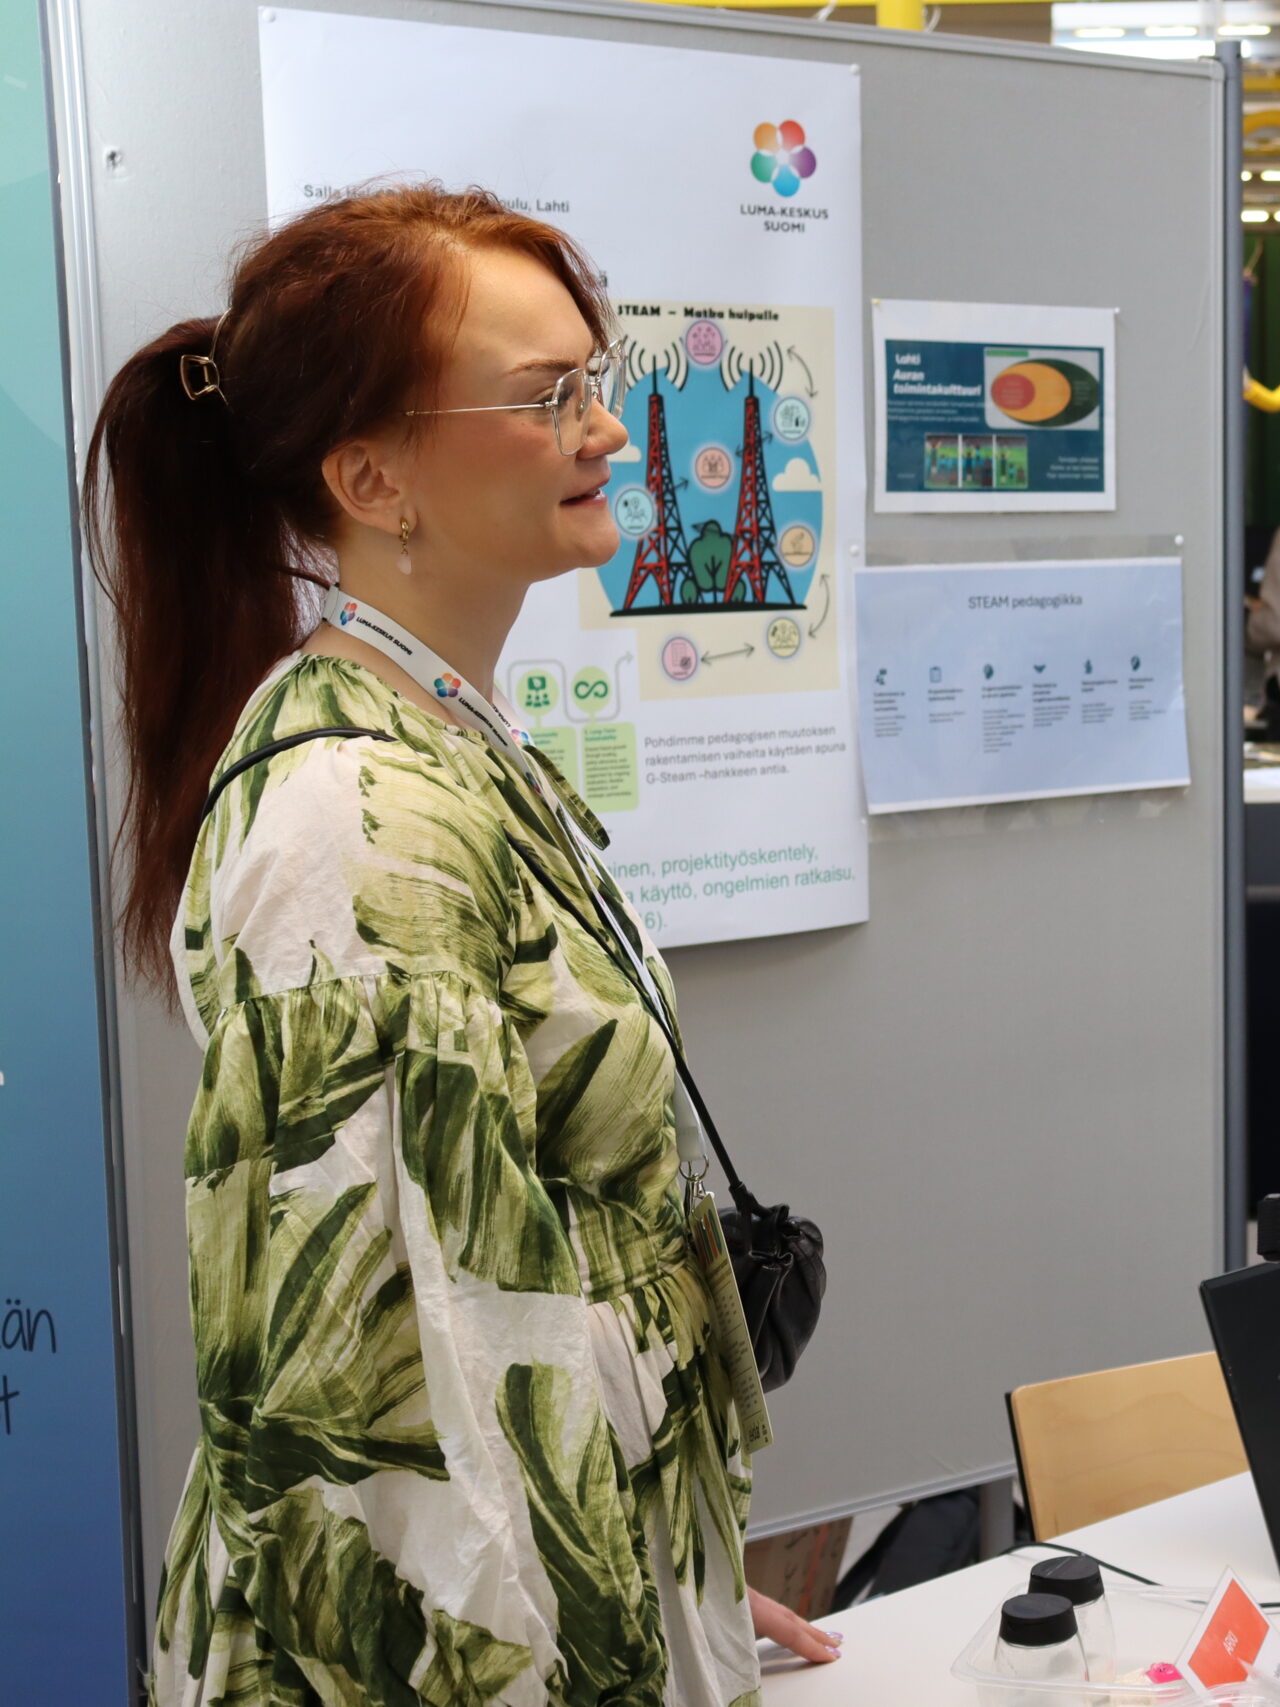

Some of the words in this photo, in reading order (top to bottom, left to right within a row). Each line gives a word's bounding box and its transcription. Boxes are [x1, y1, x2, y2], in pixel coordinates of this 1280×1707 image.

[536, 200, 570, 213] Lahti
[740, 204, 829, 220] LUMA-KESKUS
[763, 220, 806, 233] SUOMI
[728, 308, 780, 323] huipulle
[894, 353, 921, 366] Lahti
[892, 368, 926, 381] Auran
[967, 595, 1009, 610] STEAM
[1011, 592, 1083, 611] pedagogiikka
[355, 615, 395, 642] LUMA-KESKUS
[644, 733, 705, 748] Pohdimme
[707, 728, 776, 746] pedagogisen
[777, 725, 836, 740] muutoksen
[645, 749, 721, 766] rakentamisen
[723, 747, 766, 760] vaiheita
[768, 743, 813, 759] käyttäen
[815, 742, 846, 757] apuna
[646, 769, 697, 785] G-Steam
[760, 763, 790, 776] antia.
[607, 861, 656, 878] inen,
[662, 844, 819, 879] projektityöskentely,
[640, 883, 698, 906] käyttö,
[702, 872, 790, 899] ongelmien
[794, 866, 856, 887] ratkaisu,
[639, 909, 668, 933] 6).
[0, 1298, 57, 1354] än
